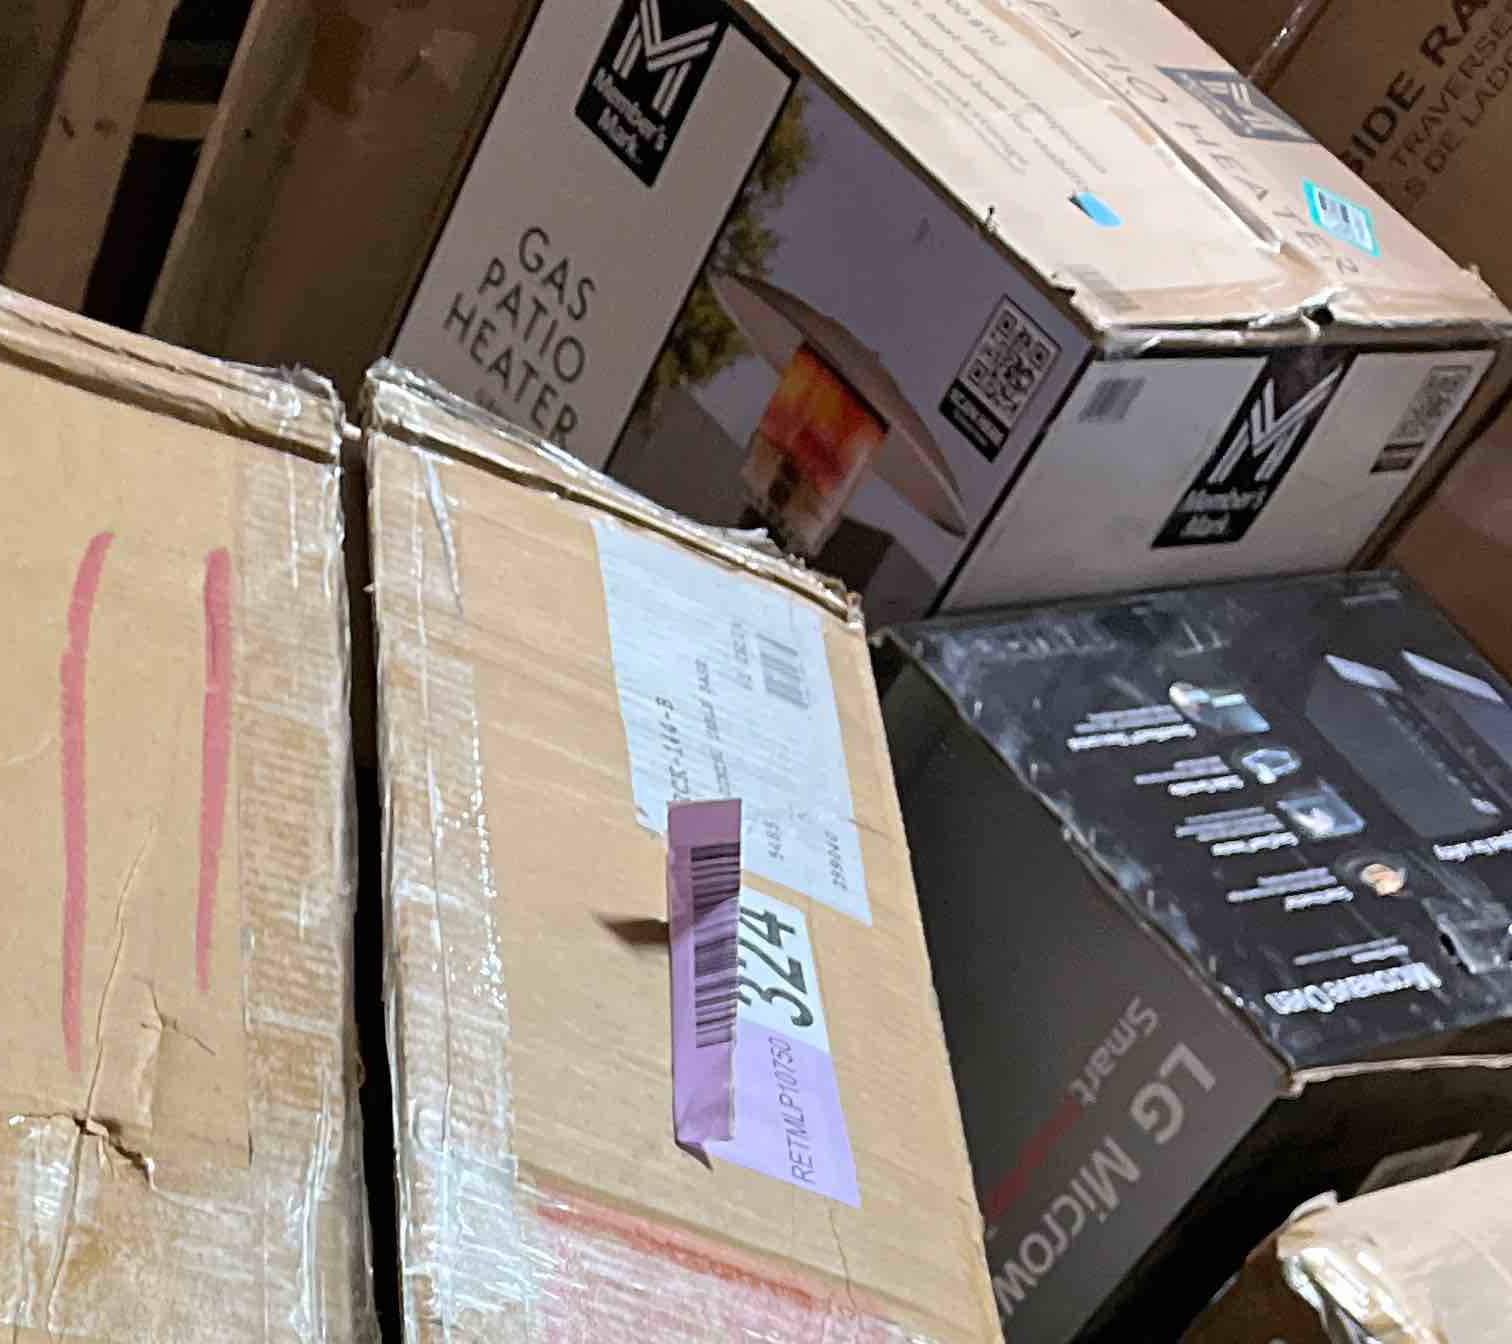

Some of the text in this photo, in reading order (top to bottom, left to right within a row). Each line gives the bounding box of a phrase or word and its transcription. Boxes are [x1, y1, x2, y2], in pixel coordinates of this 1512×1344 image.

[478, 258, 586, 383] PATIO
[518, 227, 595, 321] GAS
[443, 292, 578, 446] HEATER
[1069, 996, 1159, 1107] Smart
[1129, 1043, 1216, 1145] LG
